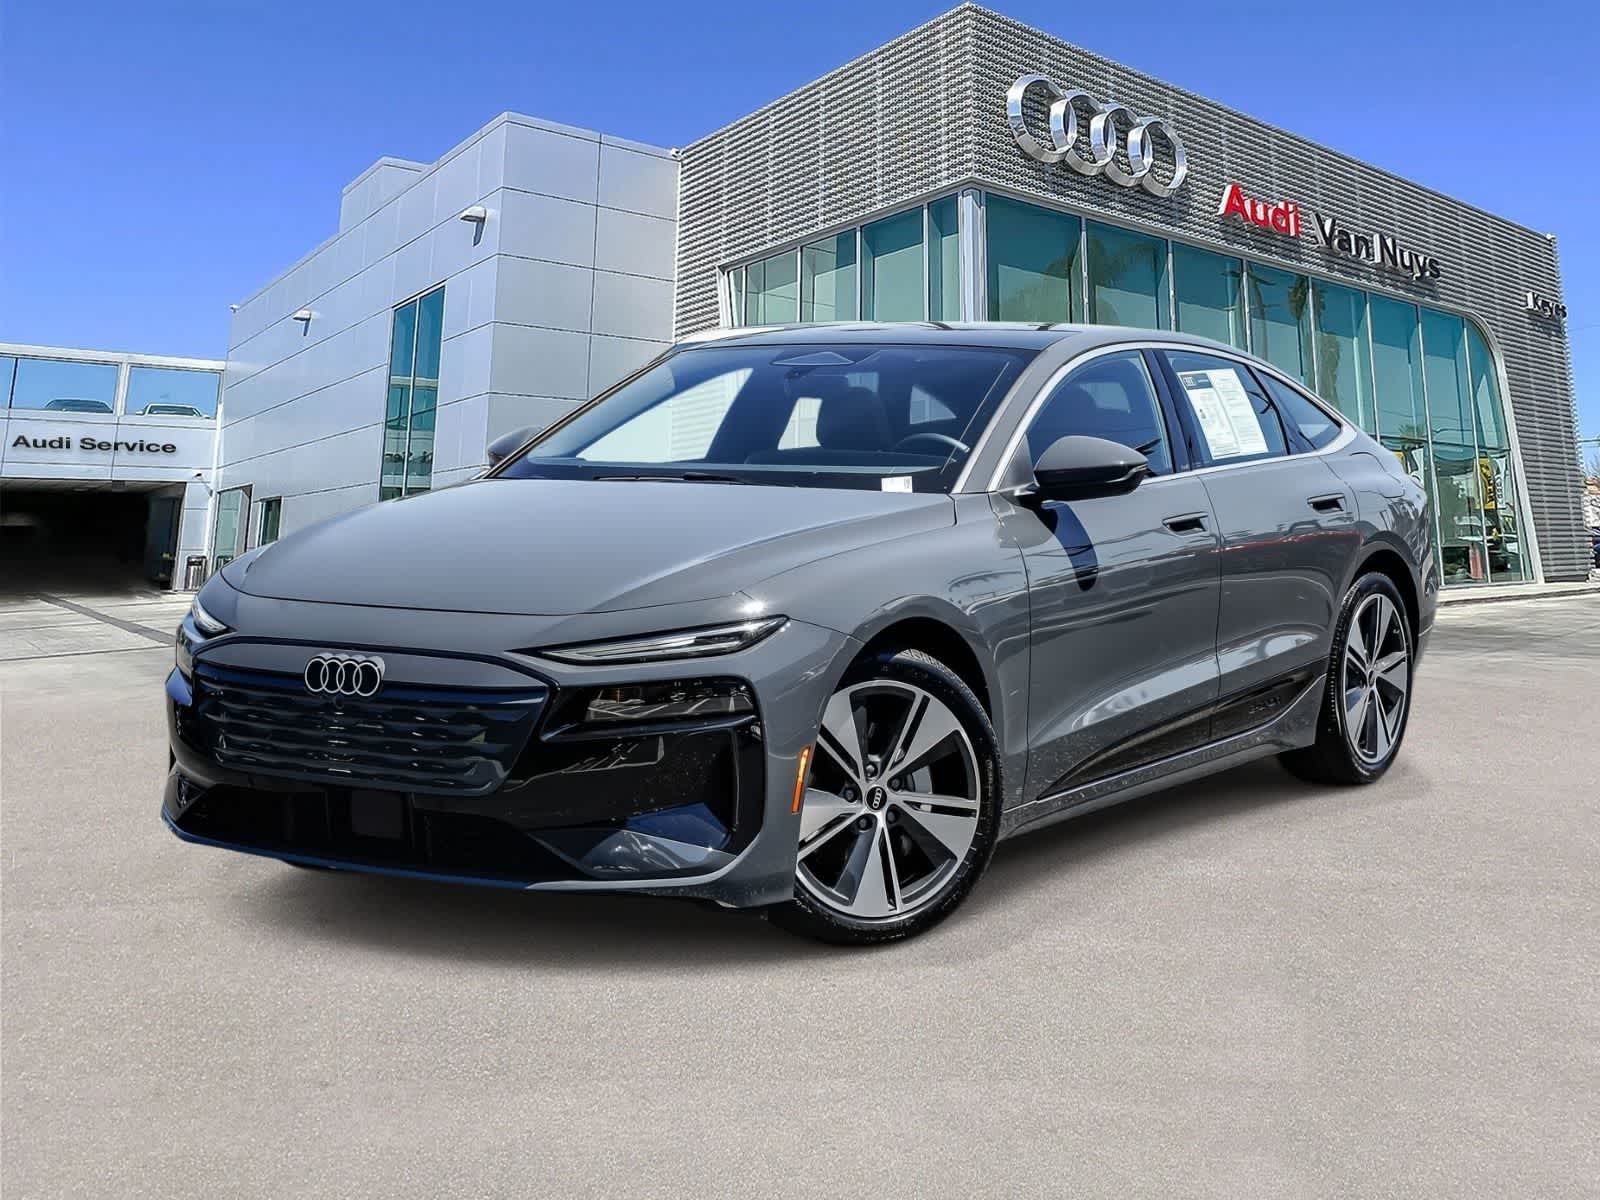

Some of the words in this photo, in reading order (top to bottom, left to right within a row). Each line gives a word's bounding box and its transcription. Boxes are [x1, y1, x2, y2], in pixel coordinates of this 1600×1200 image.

[1219, 183, 1301, 238] Audi
[1311, 212, 1371, 261] Van
[1374, 232, 1441, 280] Nuys
[1527, 291, 1567, 318] Keyes
[12, 435, 72, 450] Audi
[79, 437, 177, 454] Service
